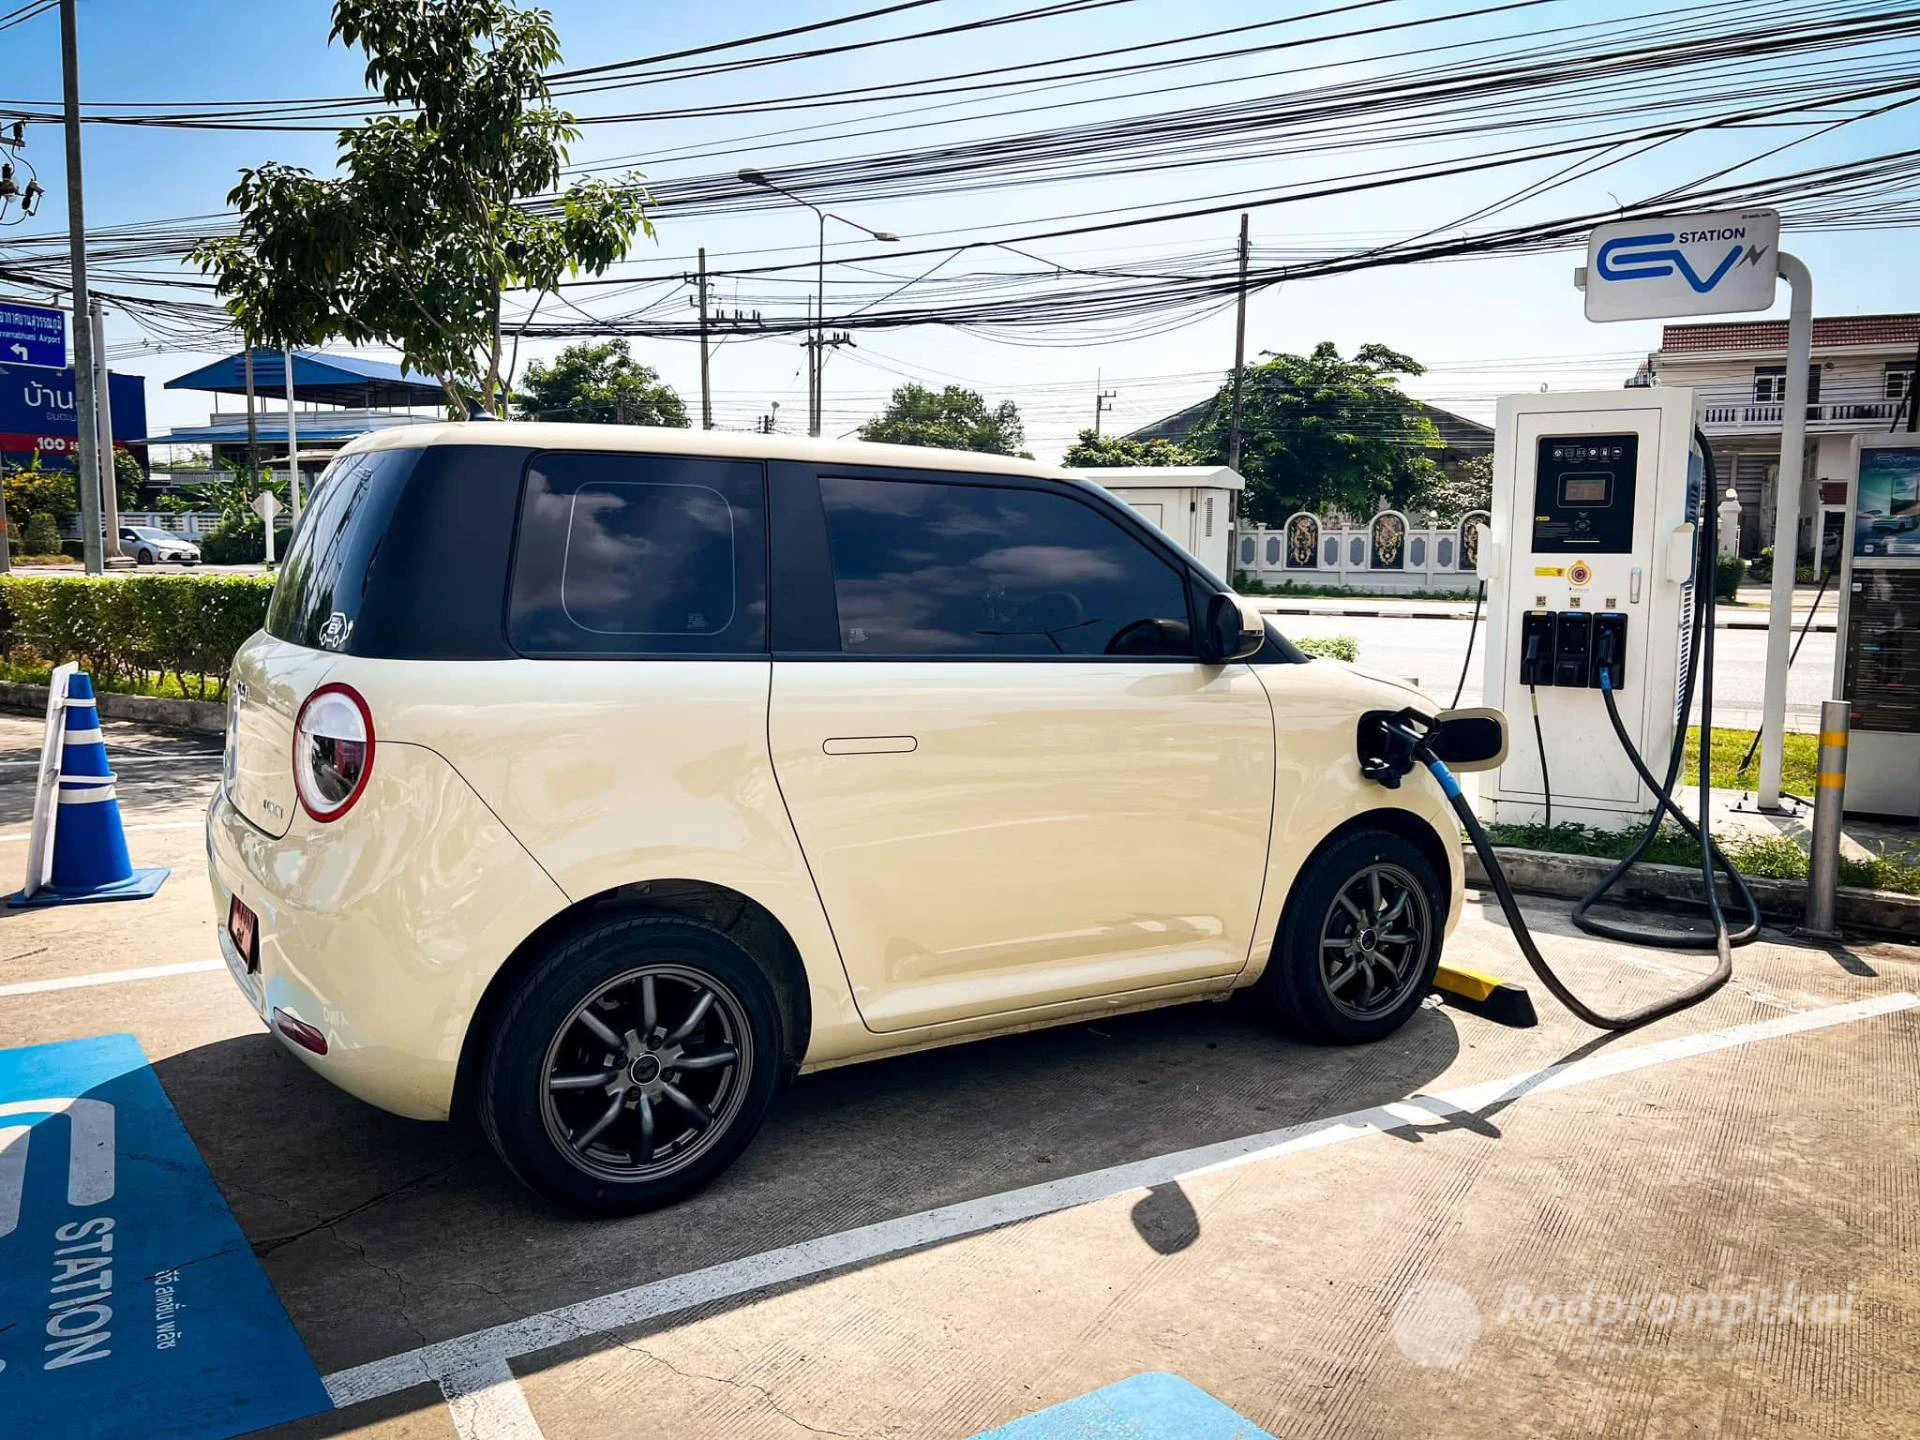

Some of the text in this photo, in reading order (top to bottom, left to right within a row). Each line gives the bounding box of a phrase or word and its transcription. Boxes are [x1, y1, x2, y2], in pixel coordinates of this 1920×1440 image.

[1596, 227, 1746, 294] EV STATION
[38, 334, 61, 344] Airport
[24, 381, 77, 409] บ้าน
[37, 437, 65, 450] 100
[44, 1217, 116, 1370] STATION
